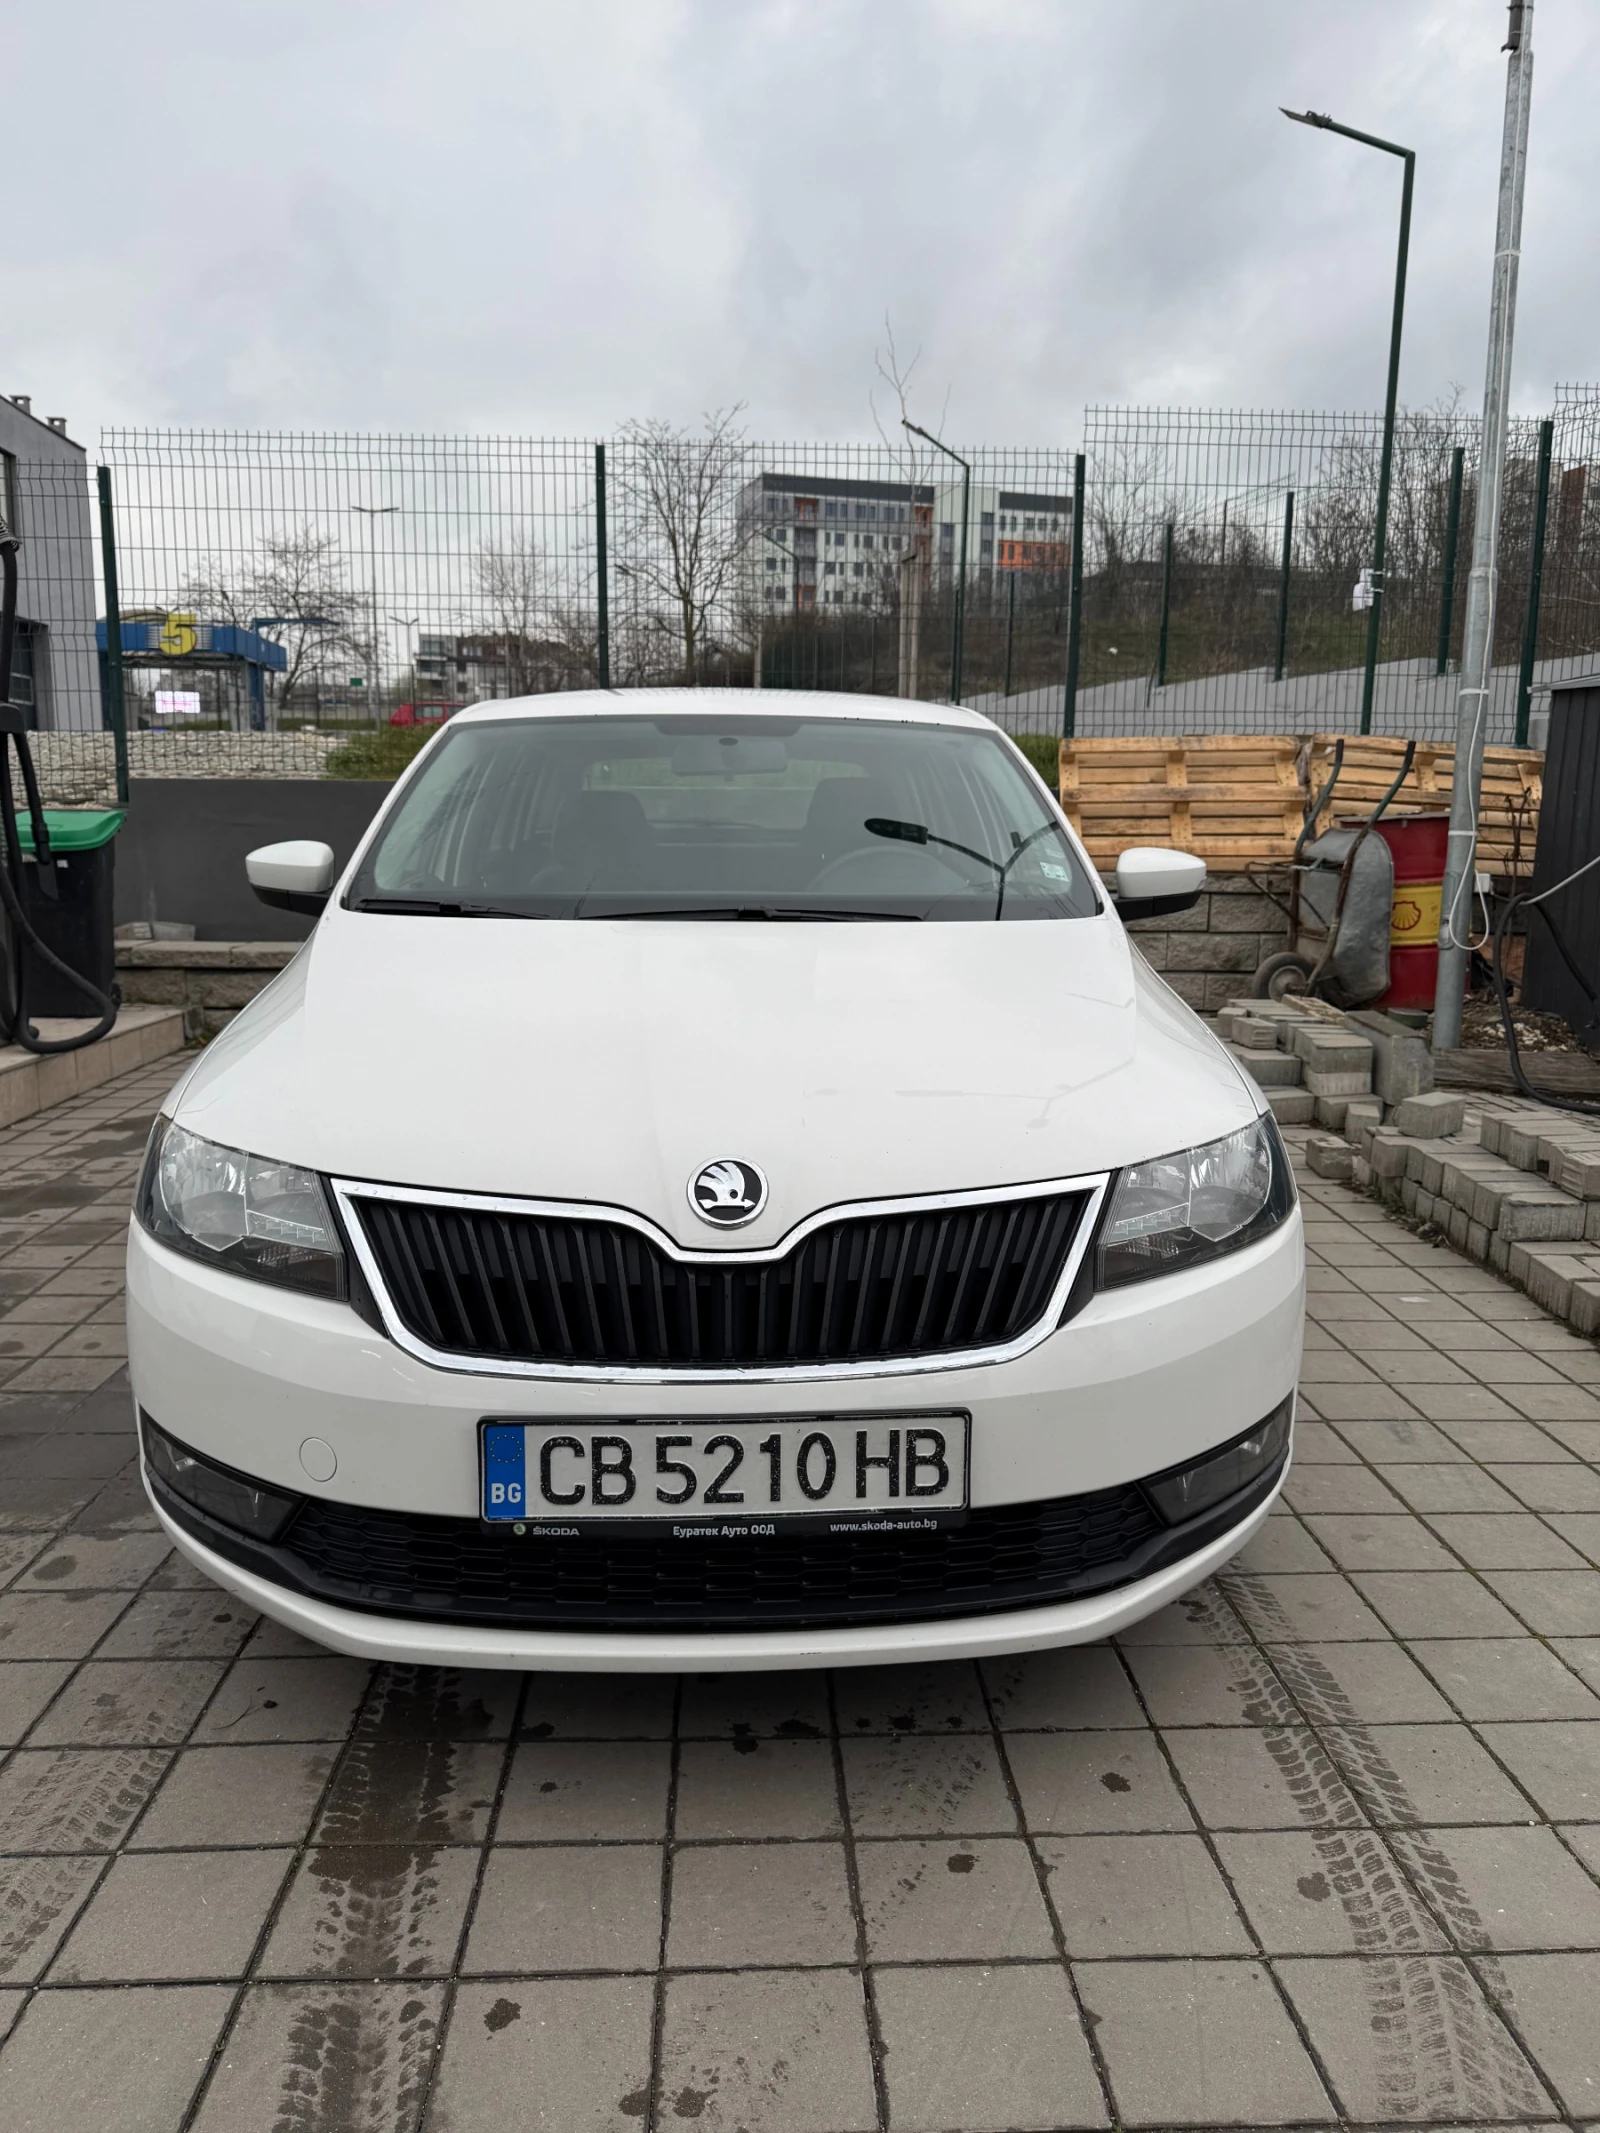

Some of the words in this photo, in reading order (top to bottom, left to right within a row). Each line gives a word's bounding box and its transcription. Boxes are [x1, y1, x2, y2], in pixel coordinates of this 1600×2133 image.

[158, 613, 197, 656] 5
[655, 1431, 838, 1504] 5210
[491, 1482, 522, 1504] BG
[532, 1526, 580, 1536] ŠKODA
[672, 1525, 719, 1537] Еуратек
[721, 1525, 748, 1536] Ауто
[750, 1523, 776, 1535] ООД
[829, 1518, 938, 1532] www.skoda-auto.bg
